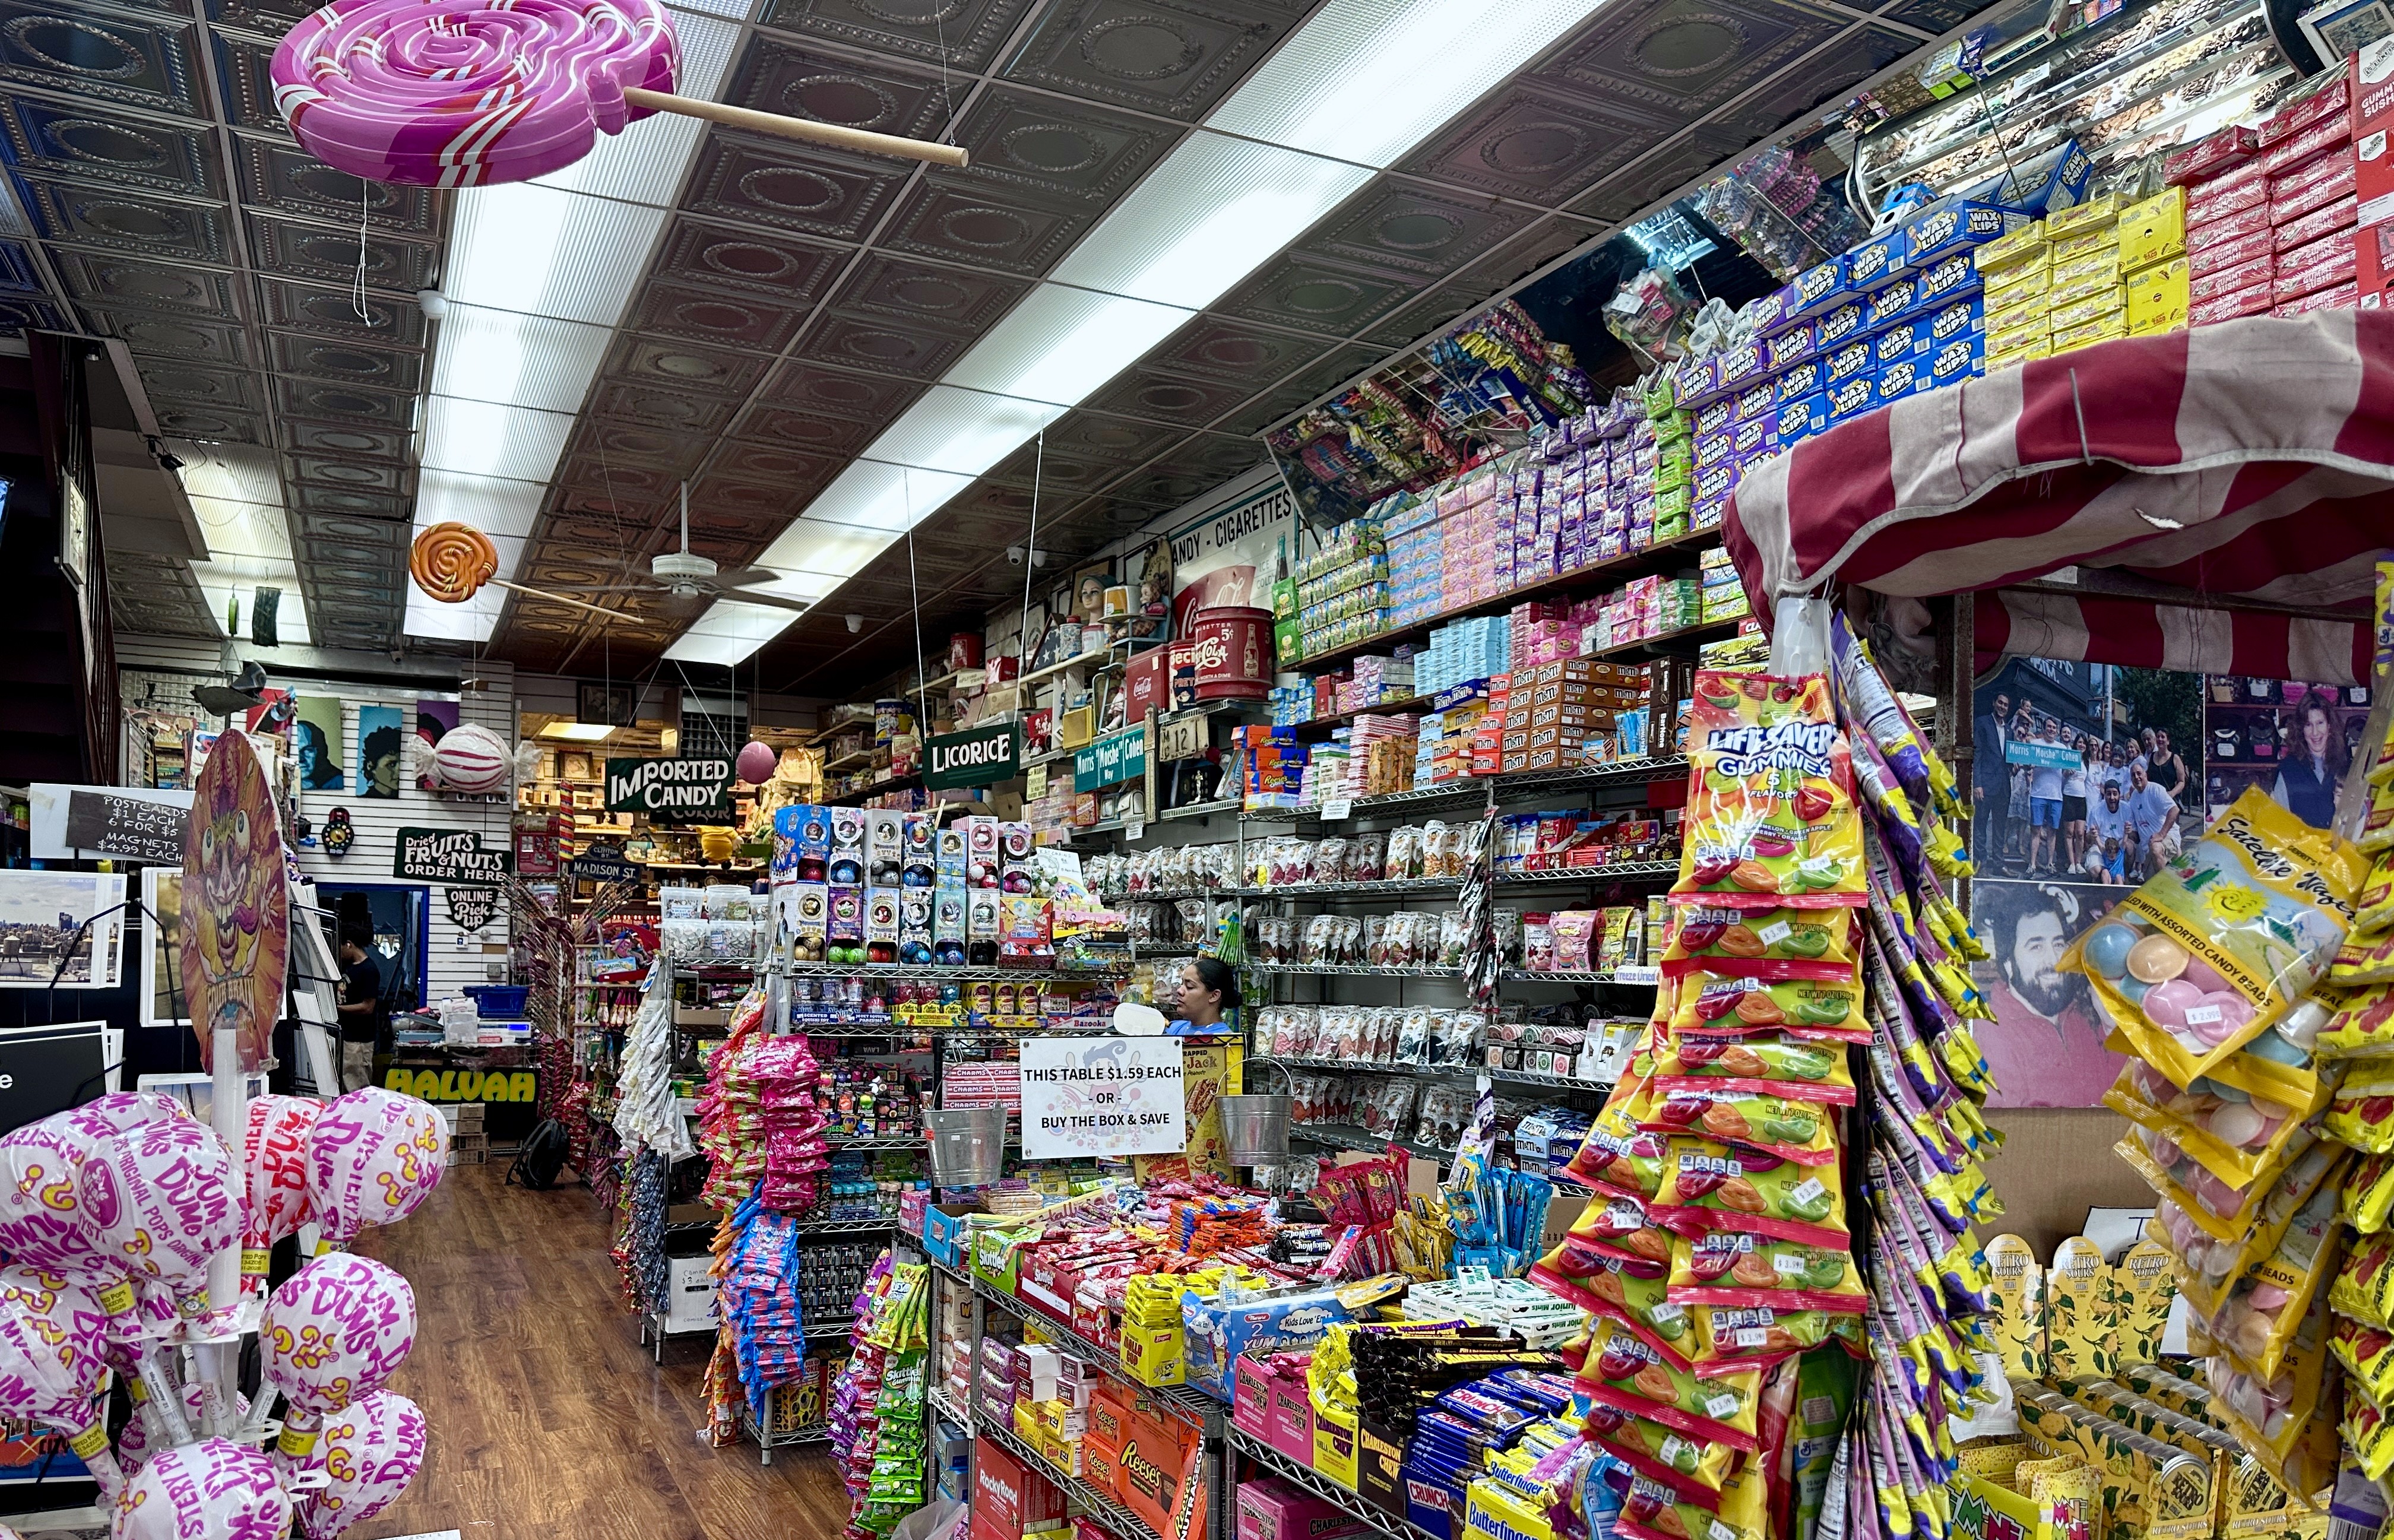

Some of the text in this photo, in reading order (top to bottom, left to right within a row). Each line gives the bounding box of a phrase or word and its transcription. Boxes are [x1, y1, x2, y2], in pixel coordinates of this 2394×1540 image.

[1969, 211, 1999, 221] WAX
[1973, 220, 1999, 231] LIPS
[1917, 212, 1952, 241] WAX
[1921, 224, 1953, 250] LIPS
[1775, 327, 1806, 353] WAX
[1779, 336, 1808, 361] FANGS
[1725, 346, 1754, 370] WAX
[1728, 354, 1756, 382] FANGS
[1215, 489, 1291, 548] CIGARETTES
[1259, 559, 1269, 572] ICE
[1175, 728, 1188, 752] 12
[932, 733, 1011, 774] LICORICE
[1077, 736, 1144, 775] Morris "Moishe" Cohen
[2009, 743, 2078, 762] Morris "Moishe" Cohen
[1716, 750, 1832, 779] GUMMIES
[610, 760, 729, 806] IMPORTED
[1104, 769, 1114, 781] Way
[1767, 773, 1781, 786] 5
[644, 781, 722, 809] CANDY
[103, 796, 188, 819] POSTCARDS
[112, 807, 176, 826] $1 EACH
[108, 817, 179, 837] 6 FOR $5
[106, 832, 179, 851] MAGNETS
[406, 832, 436, 847] Dried
[97, 839, 183, 863] $4.99 EACH
[404, 833, 475, 863] FRUITS
[450, 851, 504, 872] NUTS
[593, 847, 618, 855] CLINTON
[404, 864, 504, 882] ORDER HERE
[574, 861, 620, 876] MADISON
[450, 891, 493, 902] ONLINE
[454, 902, 491, 921] Pick
[462, 914, 483, 929] up
[2140, 902, 2162, 923] WITH
[2159, 915, 2206, 951] ASSORTED
[2204, 948, 2239, 979] CANDY
[2238, 975, 2274, 1007] BEADS
[1637, 967, 1656, 981] Dried
[1074, 1019, 1106, 1028] Bazooka
[1187, 1055, 1217, 1069] Jack
[0, 1071, 13, 1089] e
[1024, 1066, 1182, 1081] THIS TABLE $1.59 EACH
[385, 1069, 536, 1102] HALVAH
[1096, 1092, 1115, 1104] OR
[1041, 1113, 1170, 1128] BUY THE BOX & SAVE
[245, 1101, 273, 1162] CHERRY
[119, 1150, 174, 1241] ORIGINAL POPS
[978, 1250, 1006, 1270] Skittles
[2129, 1256, 2170, 1270] RETRO
[1034, 1270, 1054, 1287] Skittles
[2066, 1269, 2095, 1278] SOURS
[2133, 1268, 2161, 1278] SOURS
[1252, 1323, 1263, 1337] 2
[1284, 1317, 1298, 1327] Kids
[1299, 1316, 1314, 1326] Love
[1123, 1335, 1144, 1358] MALLO
[1243, 1336, 1276, 1351] YUM
[1017, 1358, 1028, 1370] TAFFY
[1126, 1350, 1139, 1367] CUP
[1239, 1368, 1269, 1396] CHARLESTON
[774, 1389, 783, 1428] JOKE
[1253, 1392, 1269, 1412] CHEW
[1277, 1392, 1307, 1417] CHARLESTON
[1448, 1388, 1507, 1415] CRUNCH
[1095, 1403, 1117, 1430] Reese's
[1292, 1412, 1307, 1433] CHEW
[1316, 1414, 1354, 1443] CHARLESTON
[1332, 1436, 1354, 1460] CHEW
[1361, 1428, 1402, 1462] CHARLESTON
[1088, 1448, 1110, 1476] Reese's
[1120, 1440, 1161, 1489] Reese's
[1379, 1454, 1400, 1482] CHEW
[1491, 1461, 1544, 1495] Butterfinger
[1408, 1482, 1450, 1509] CRUNCH
[2181, 1521, 2208, 1531] SOURS
